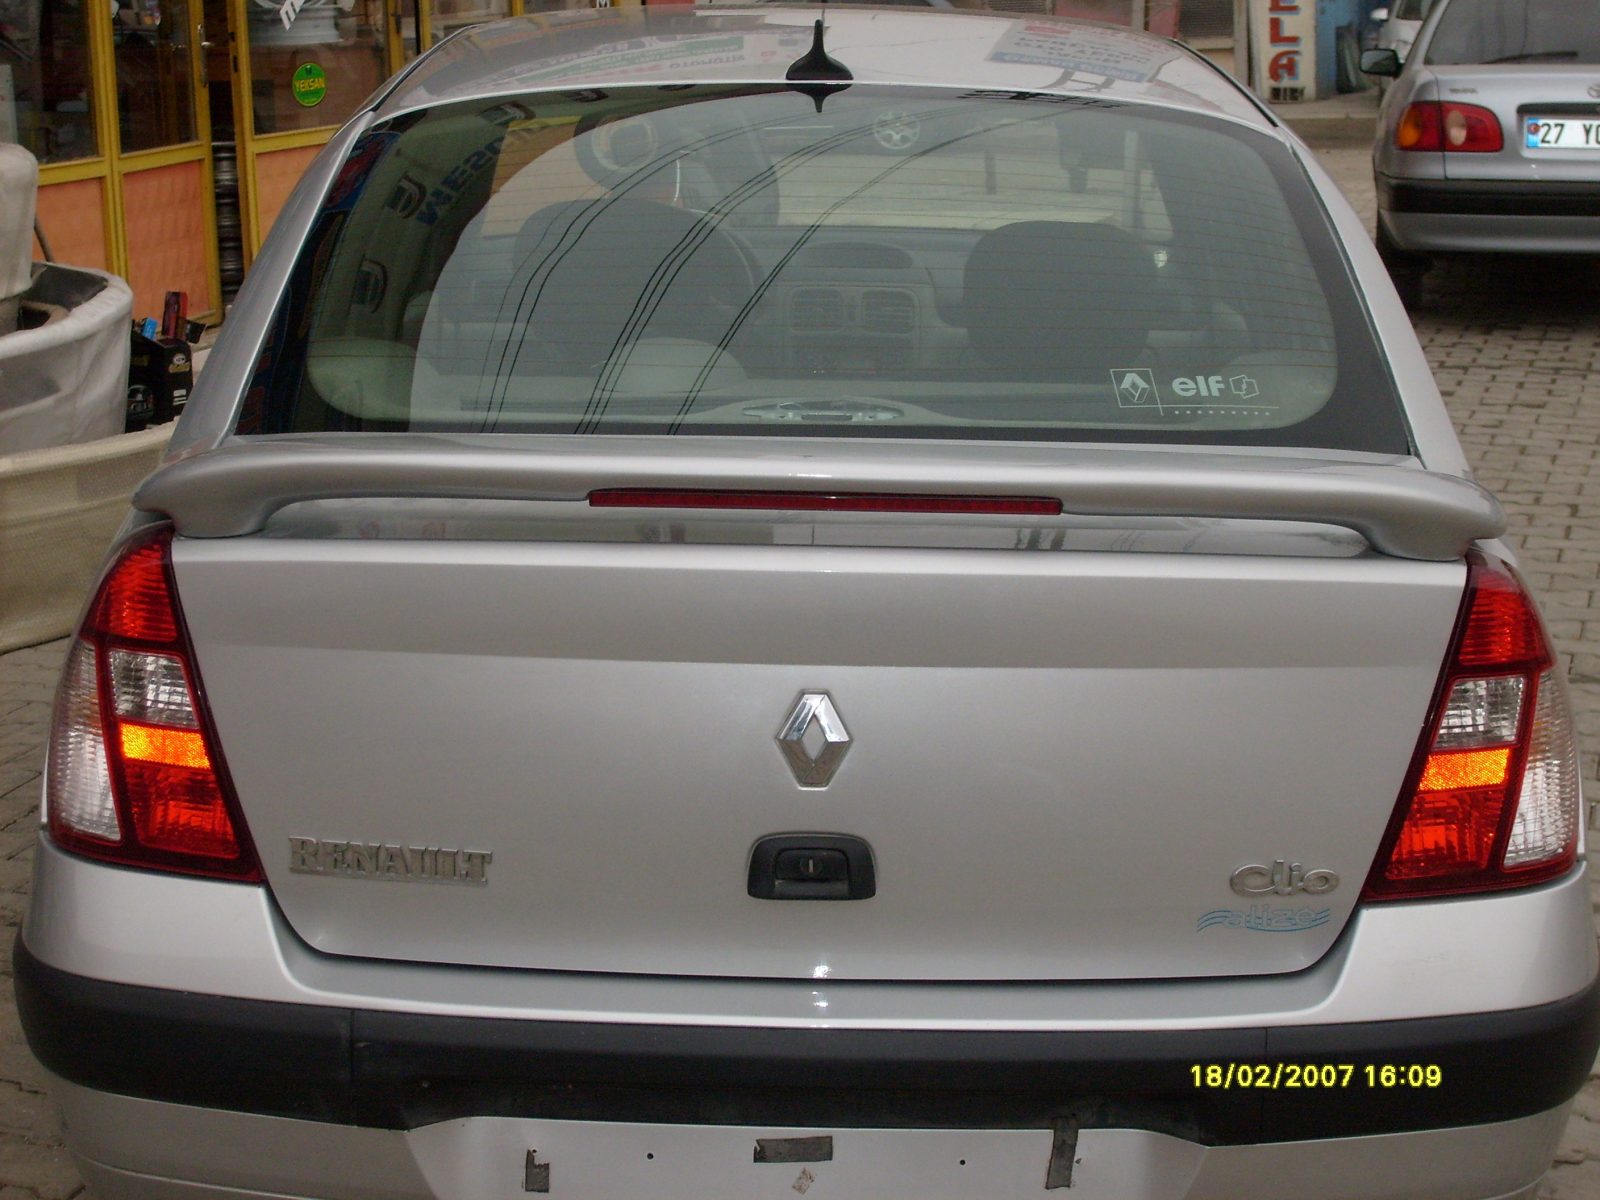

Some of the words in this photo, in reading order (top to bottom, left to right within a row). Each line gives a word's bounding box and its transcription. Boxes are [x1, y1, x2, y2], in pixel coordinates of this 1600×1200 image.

[1540, 122, 1565, 144] 27
[1171, 375, 1226, 397] elf
[288, 836, 493, 887] RENAULT
[1230, 859, 1340, 897] Clio
